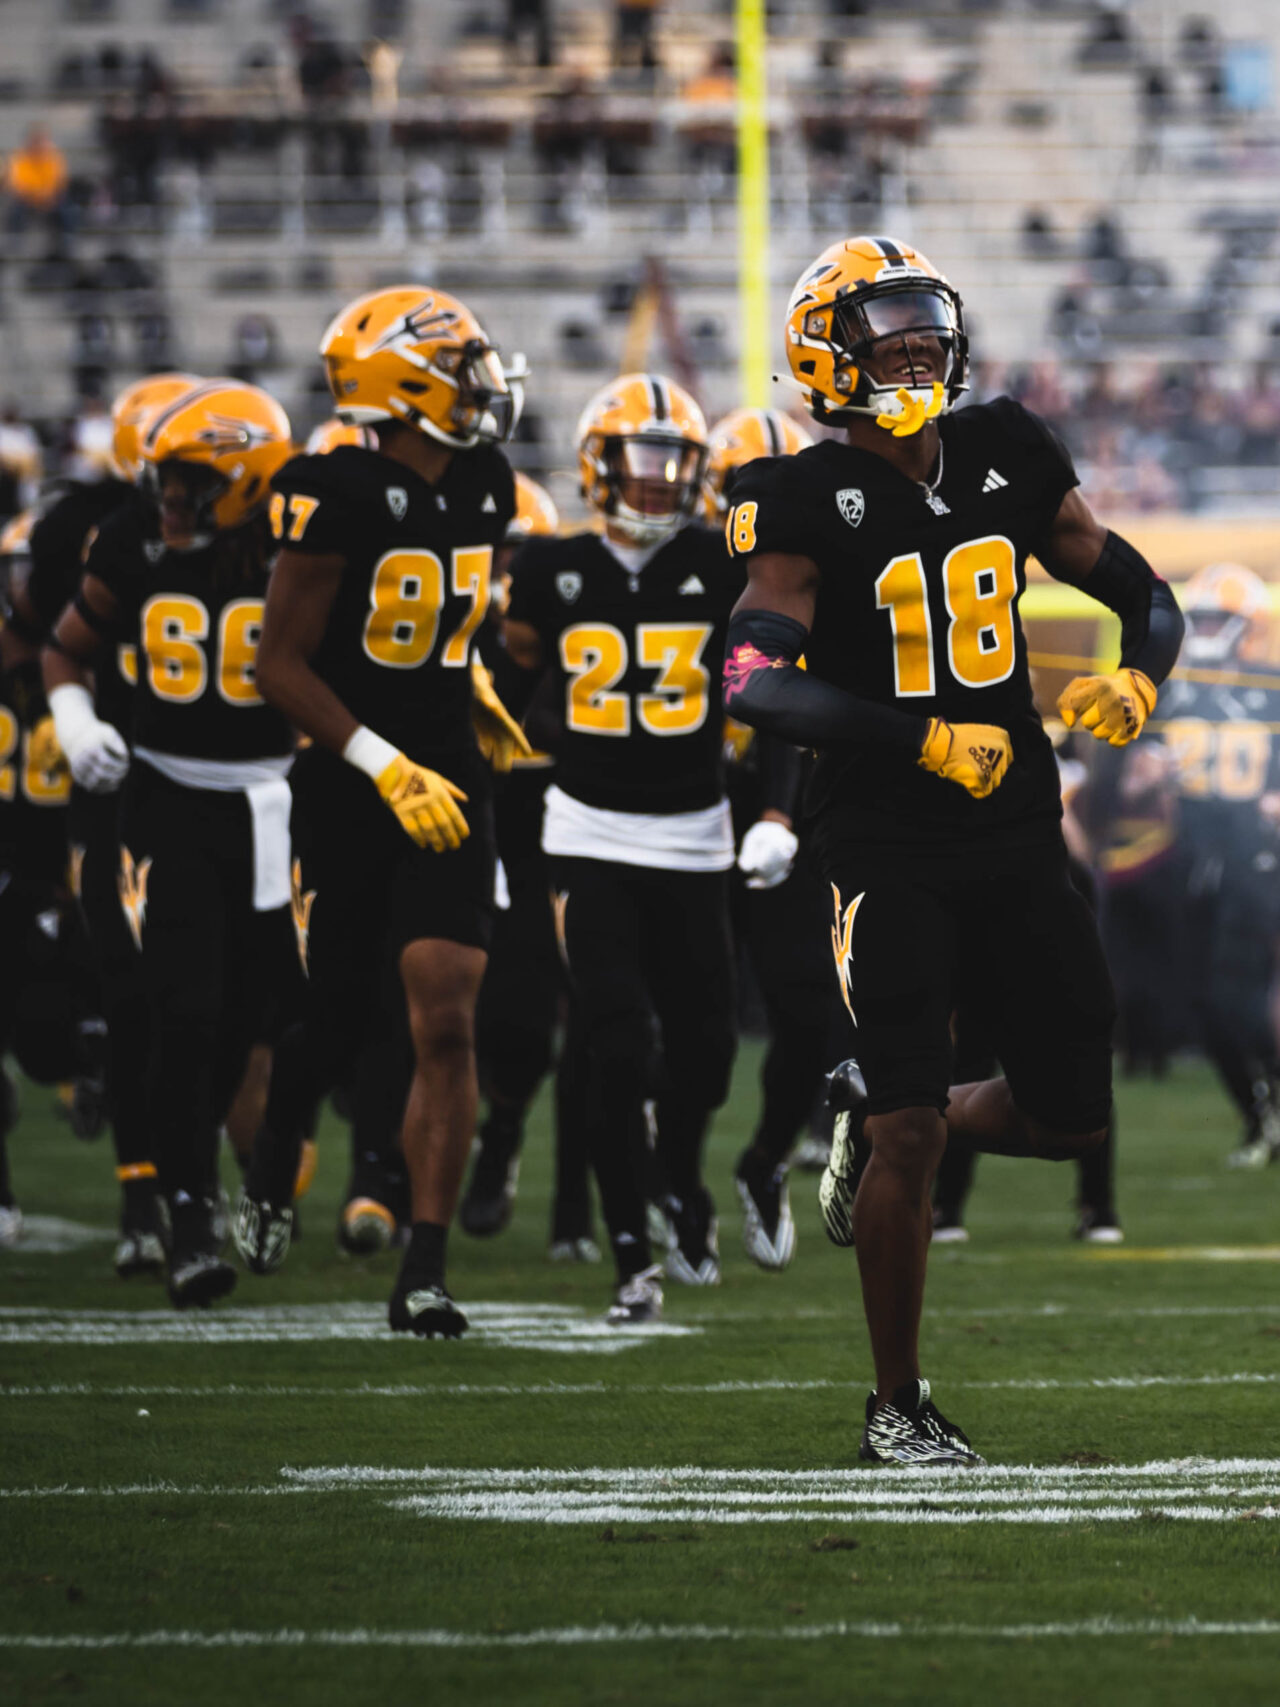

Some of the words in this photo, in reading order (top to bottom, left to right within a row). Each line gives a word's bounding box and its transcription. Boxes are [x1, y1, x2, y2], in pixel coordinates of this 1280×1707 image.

[363, 544, 494, 670] 87
[875, 534, 1018, 698] 18
[559, 622, 714, 738] 23
